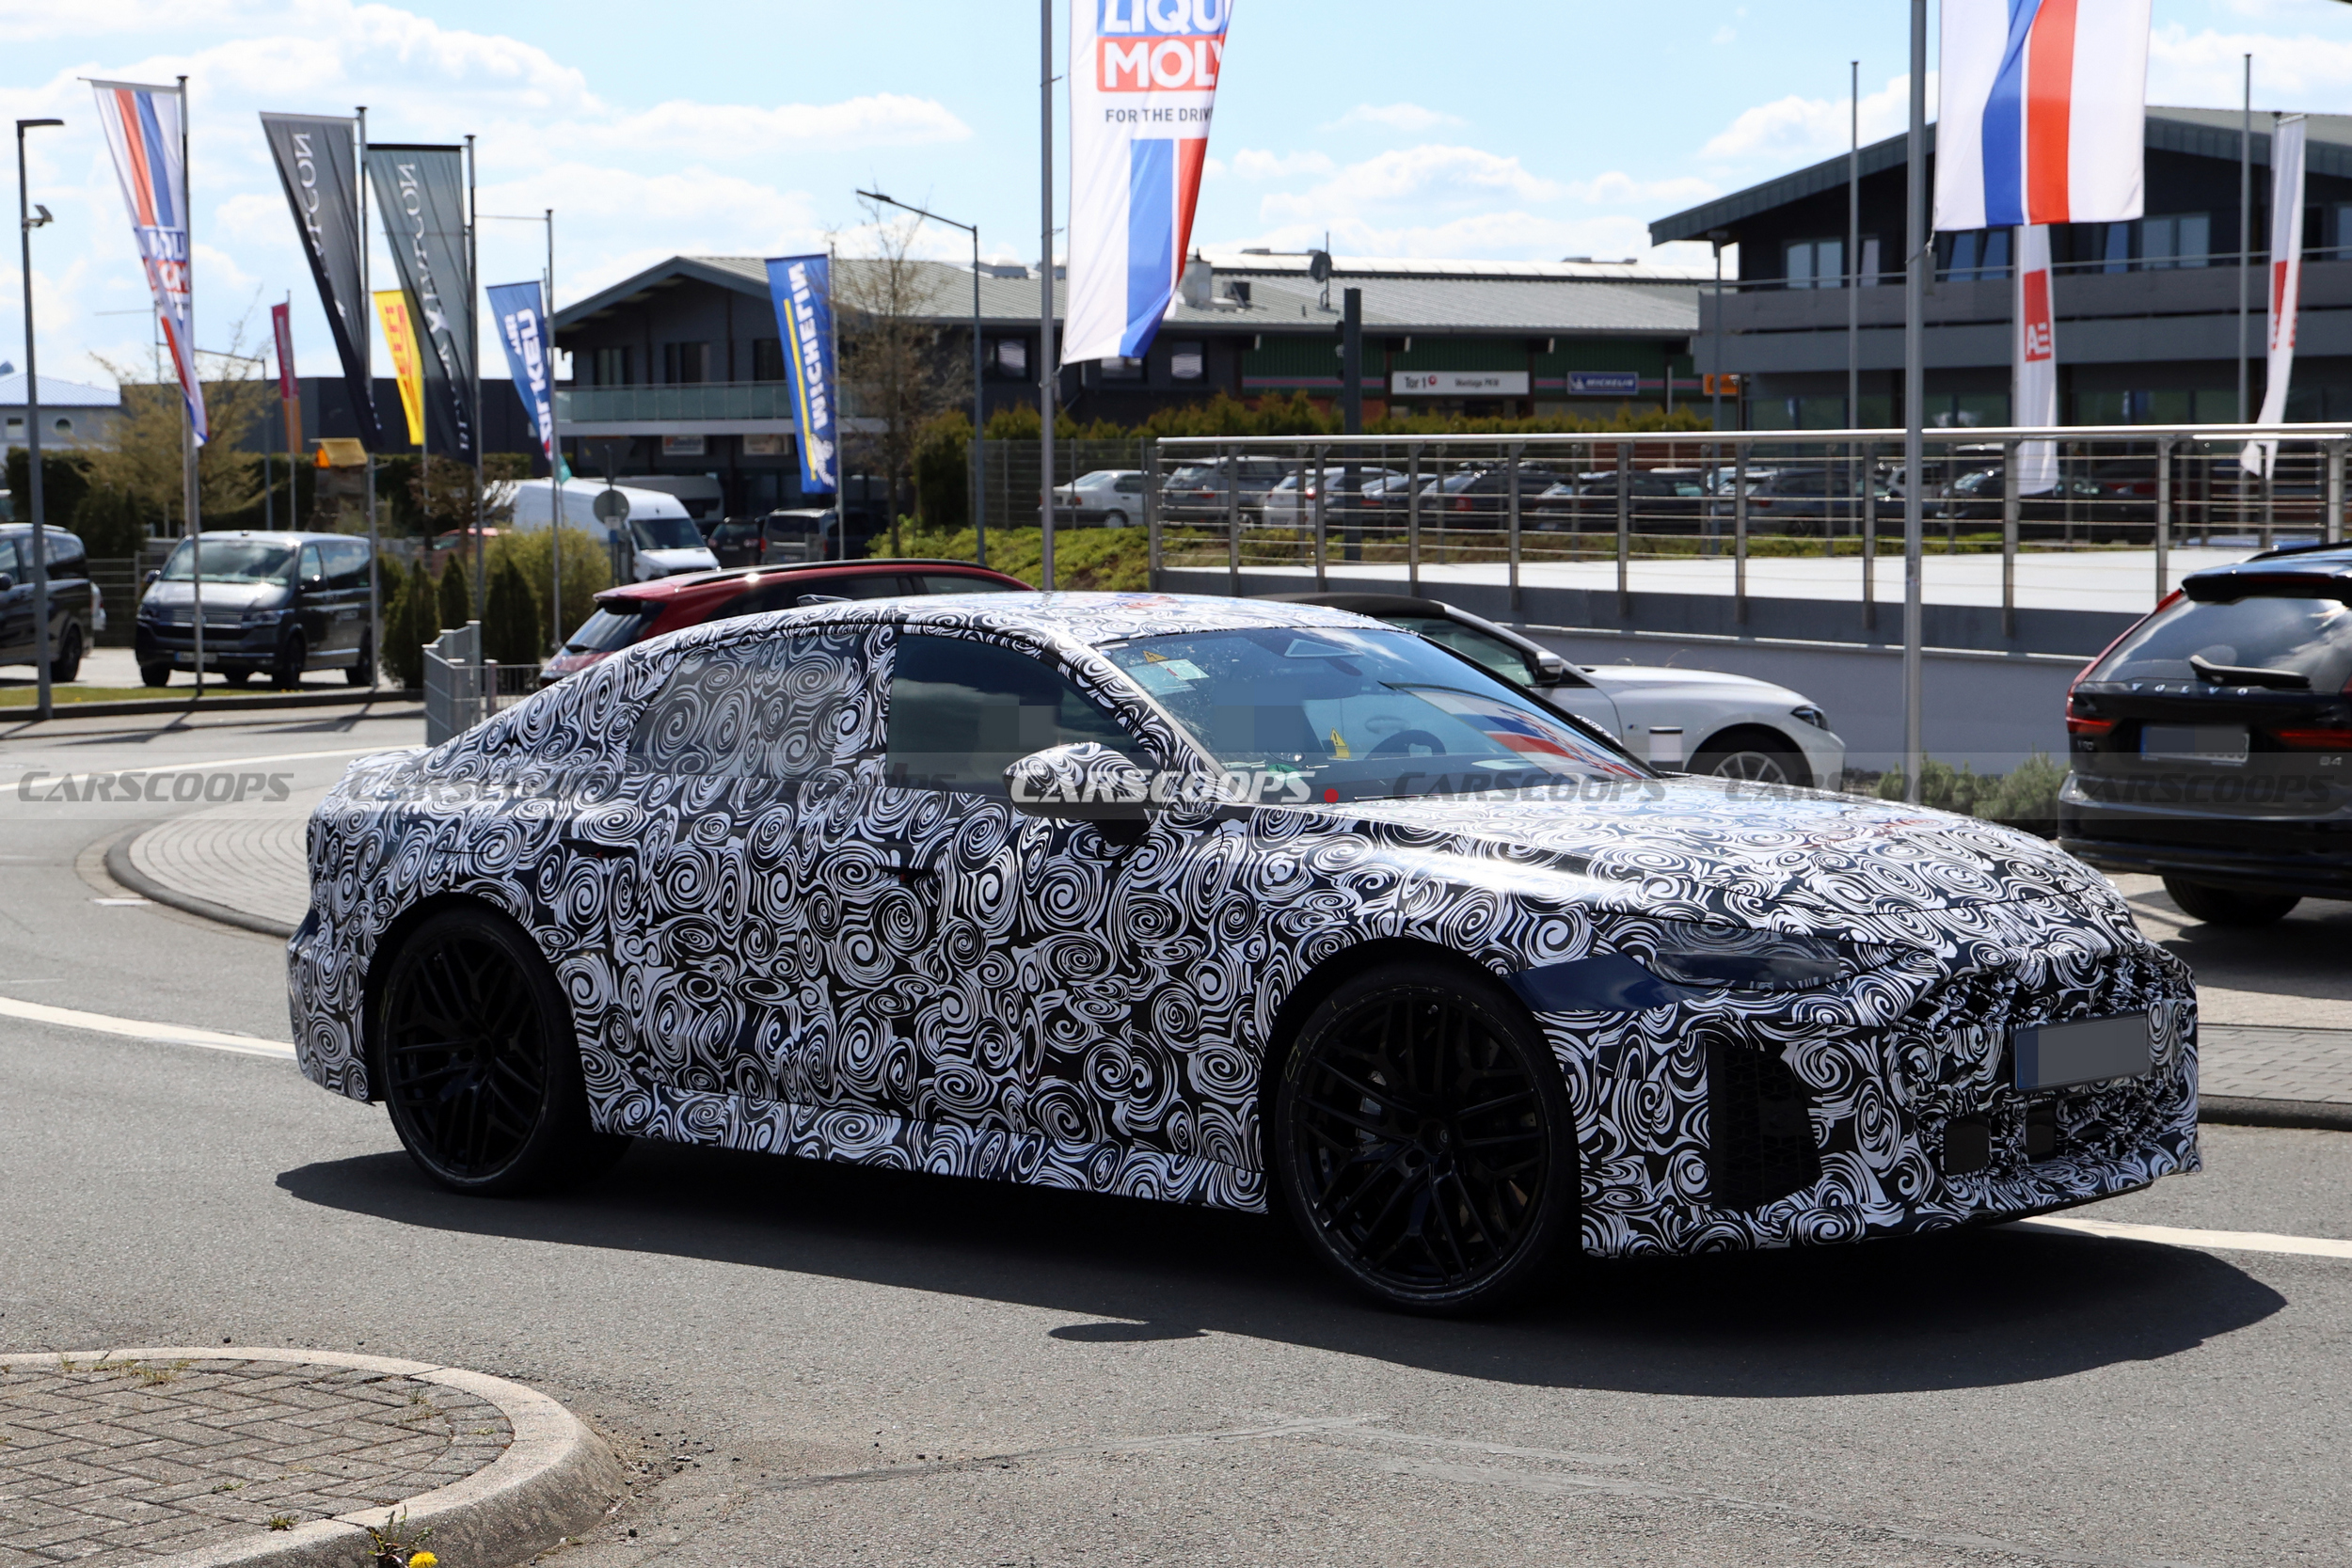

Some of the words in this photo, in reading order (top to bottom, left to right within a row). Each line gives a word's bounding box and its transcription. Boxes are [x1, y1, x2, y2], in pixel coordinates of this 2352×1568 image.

[1104, 0, 1231, 35] LIQU
[1105, 109, 1137, 122] FOR
[1142, 108, 1173, 122] THE
[1586, 378, 1634, 387] MICHELIN
[2132, 682, 2249, 695] VOLVO
